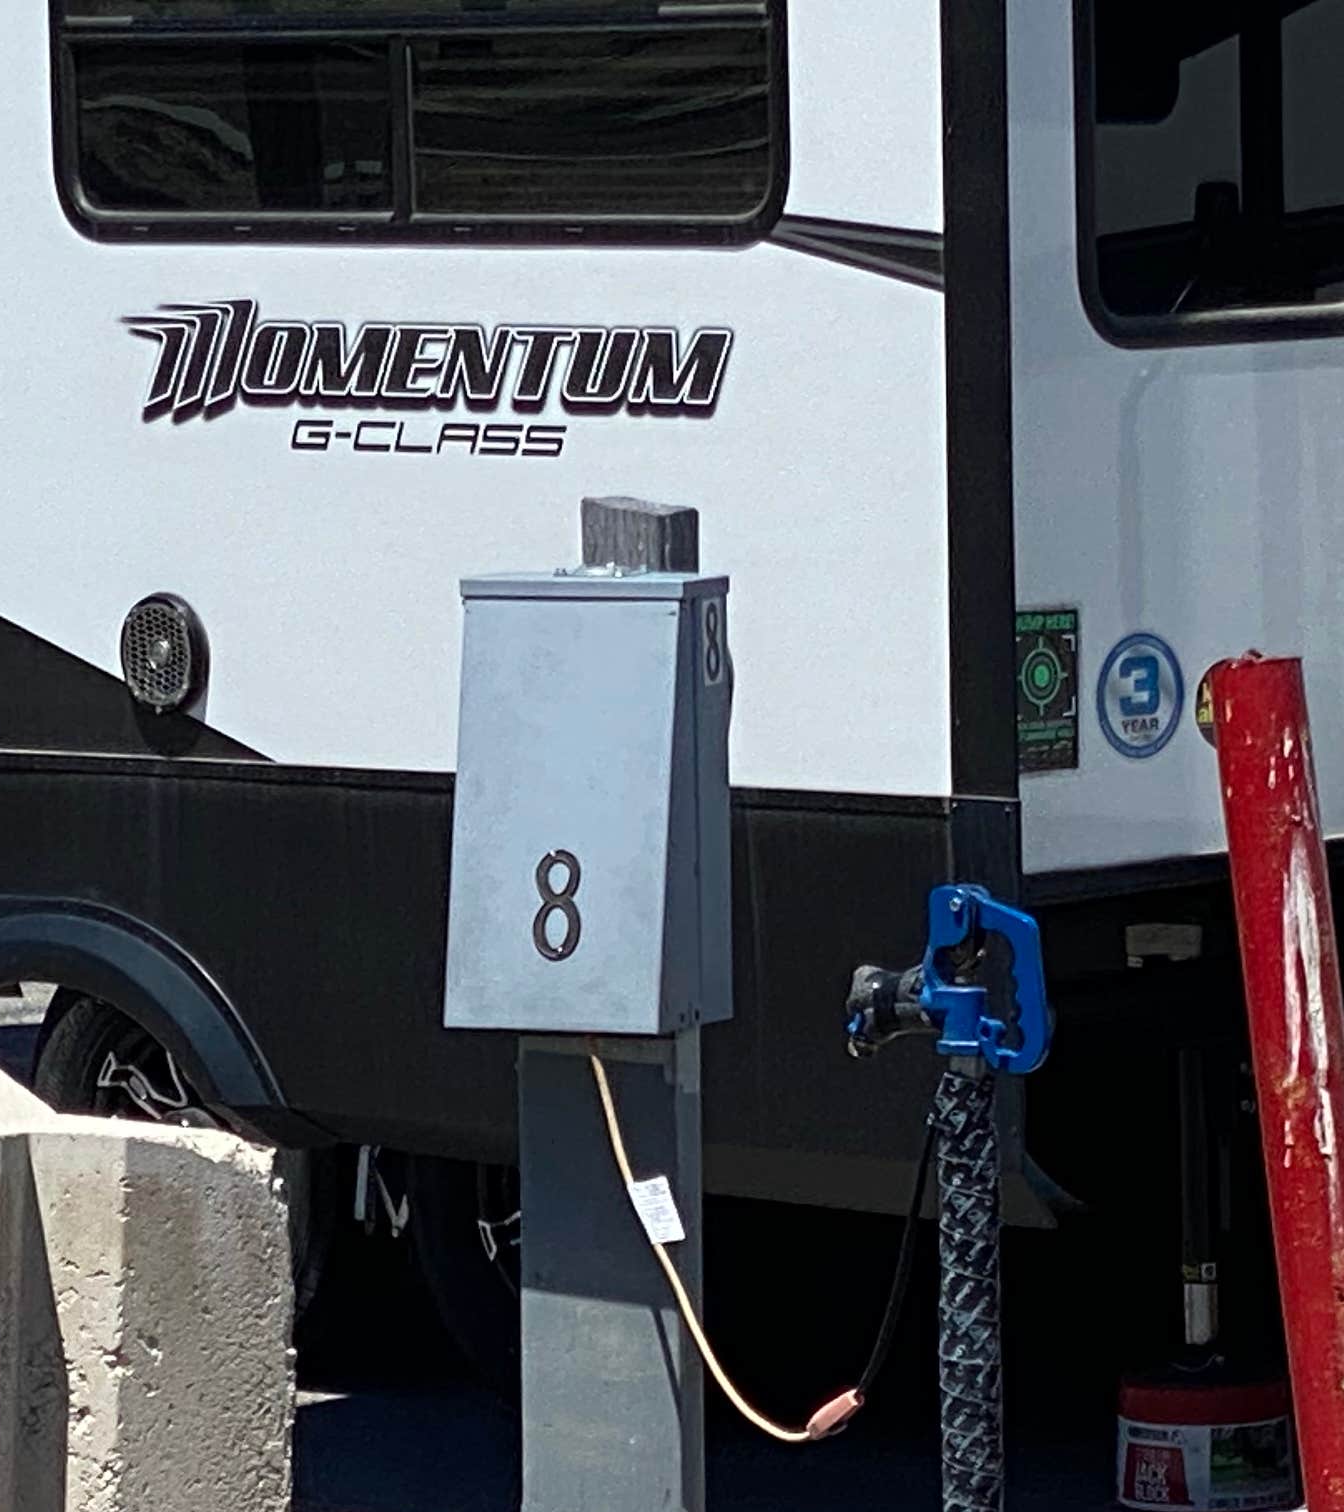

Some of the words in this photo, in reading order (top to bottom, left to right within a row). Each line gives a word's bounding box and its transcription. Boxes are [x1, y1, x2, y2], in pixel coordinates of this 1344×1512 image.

[120, 299, 735, 424] MOMENTUM
[289, 419, 568, 457] G-CLASS
[703, 602, 721, 682] 8
[1119, 656, 1160, 716] 3
[1122, 719, 1159, 734] YEAR
[532, 848, 582, 962] 8
